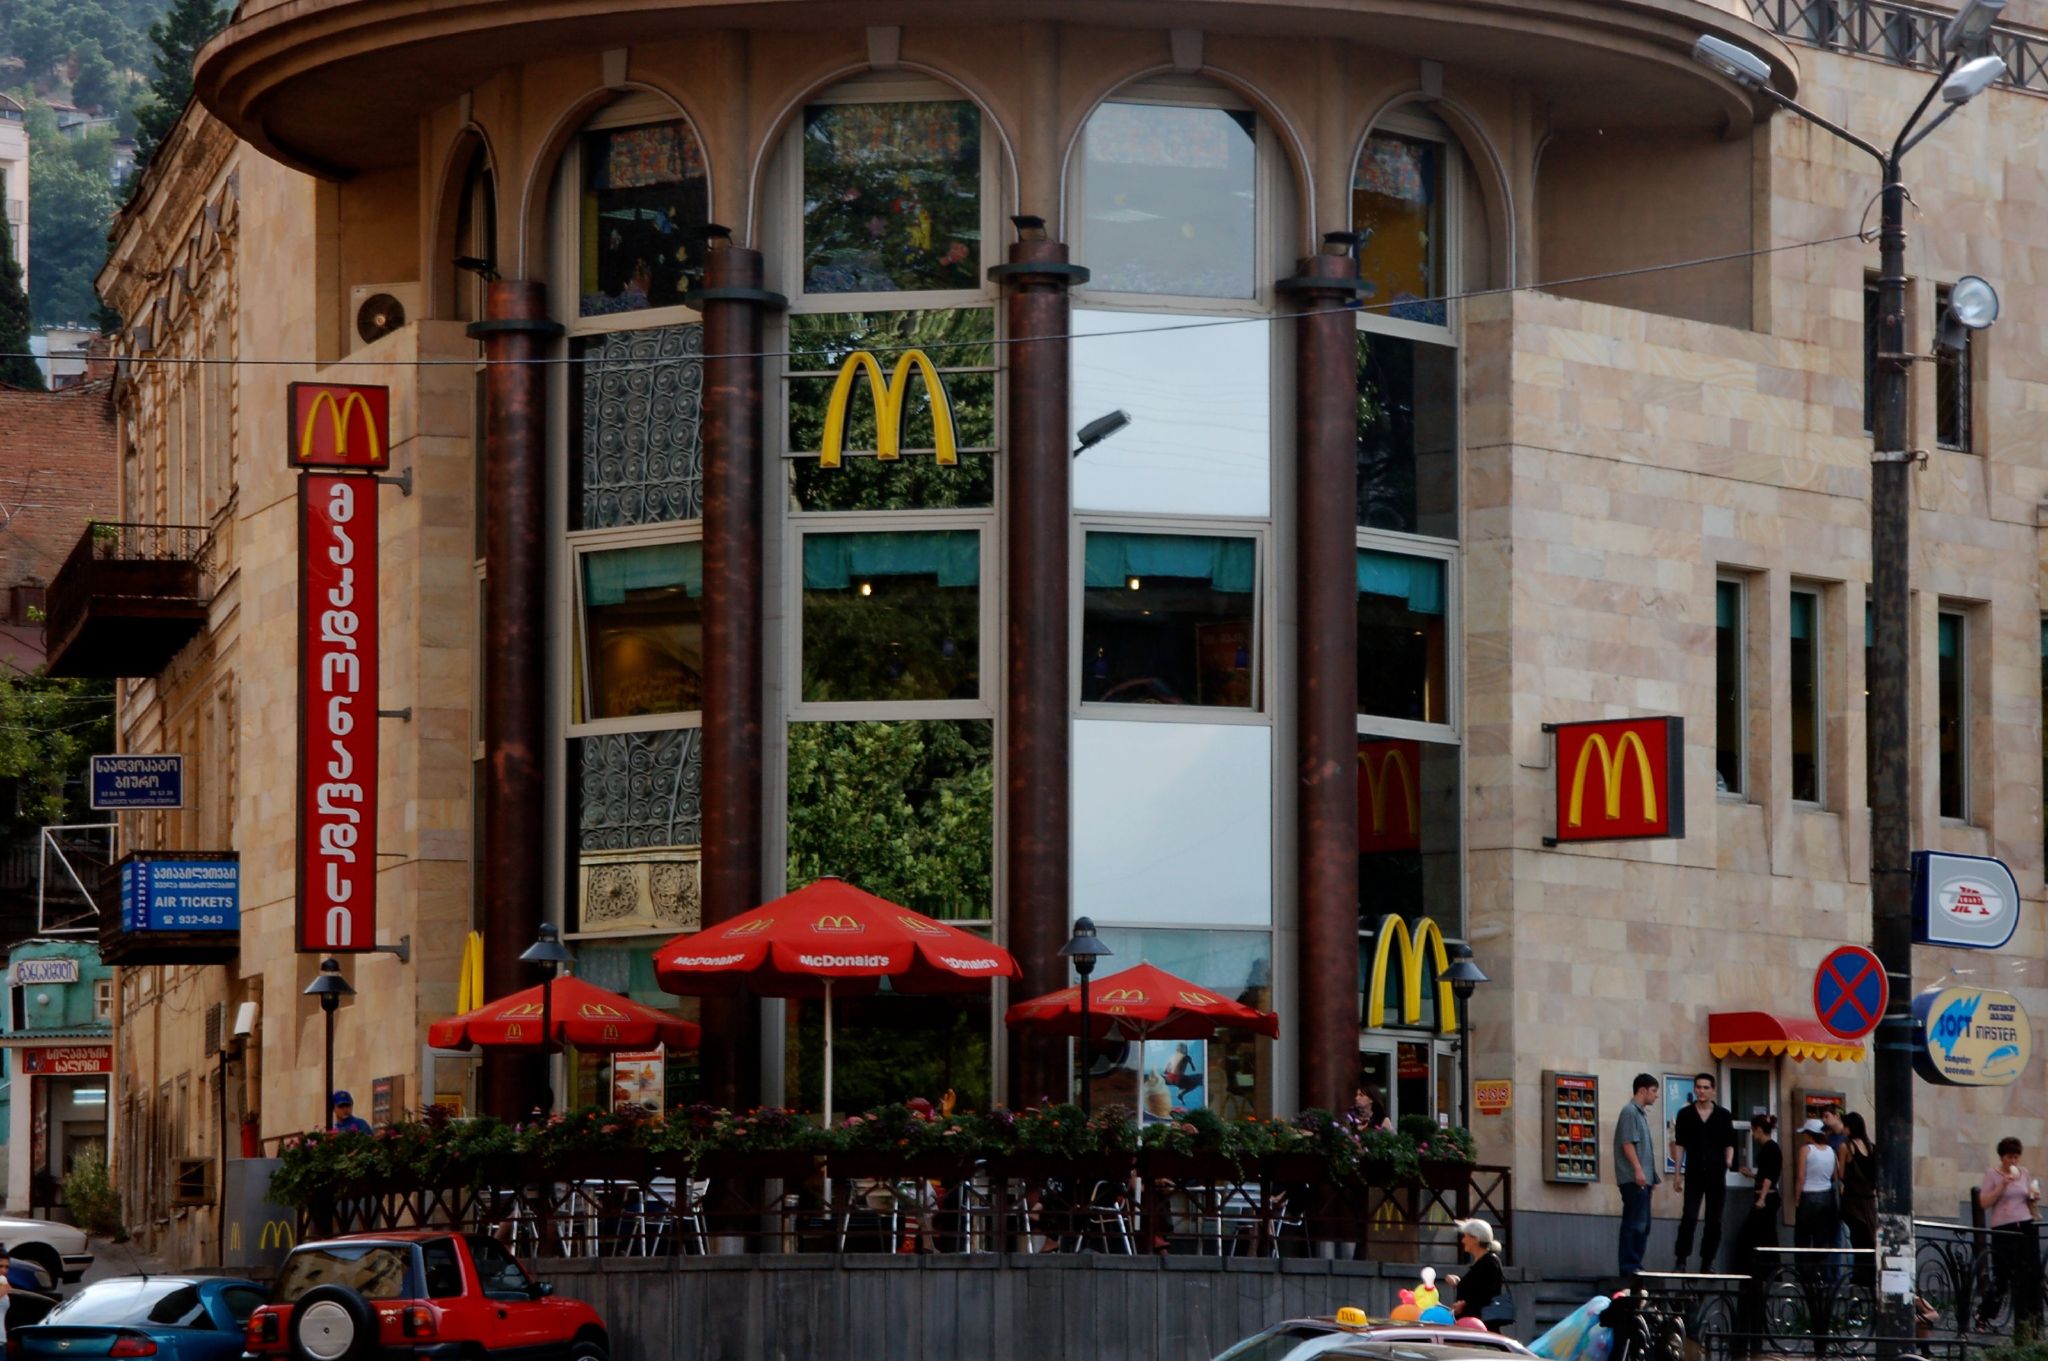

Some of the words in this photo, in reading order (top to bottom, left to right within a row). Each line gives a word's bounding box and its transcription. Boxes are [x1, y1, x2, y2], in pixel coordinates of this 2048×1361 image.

[316, 482, 364, 947] მაკდონალდსი
[96, 759, 178, 773] საადვოკატო
[115, 775, 160, 789] ბიურო
[153, 867, 237, 880] ავიაბილეთები
[155, 896, 177, 907] AIR
[180, 896, 233, 908] TICKETS
[799, 954, 890, 967] McDonald's
[1939, 1014, 1973, 1038] SOFT
[1976, 1025, 2017, 1042] MASTER
[55, 1059, 100, 1073] სალონი
